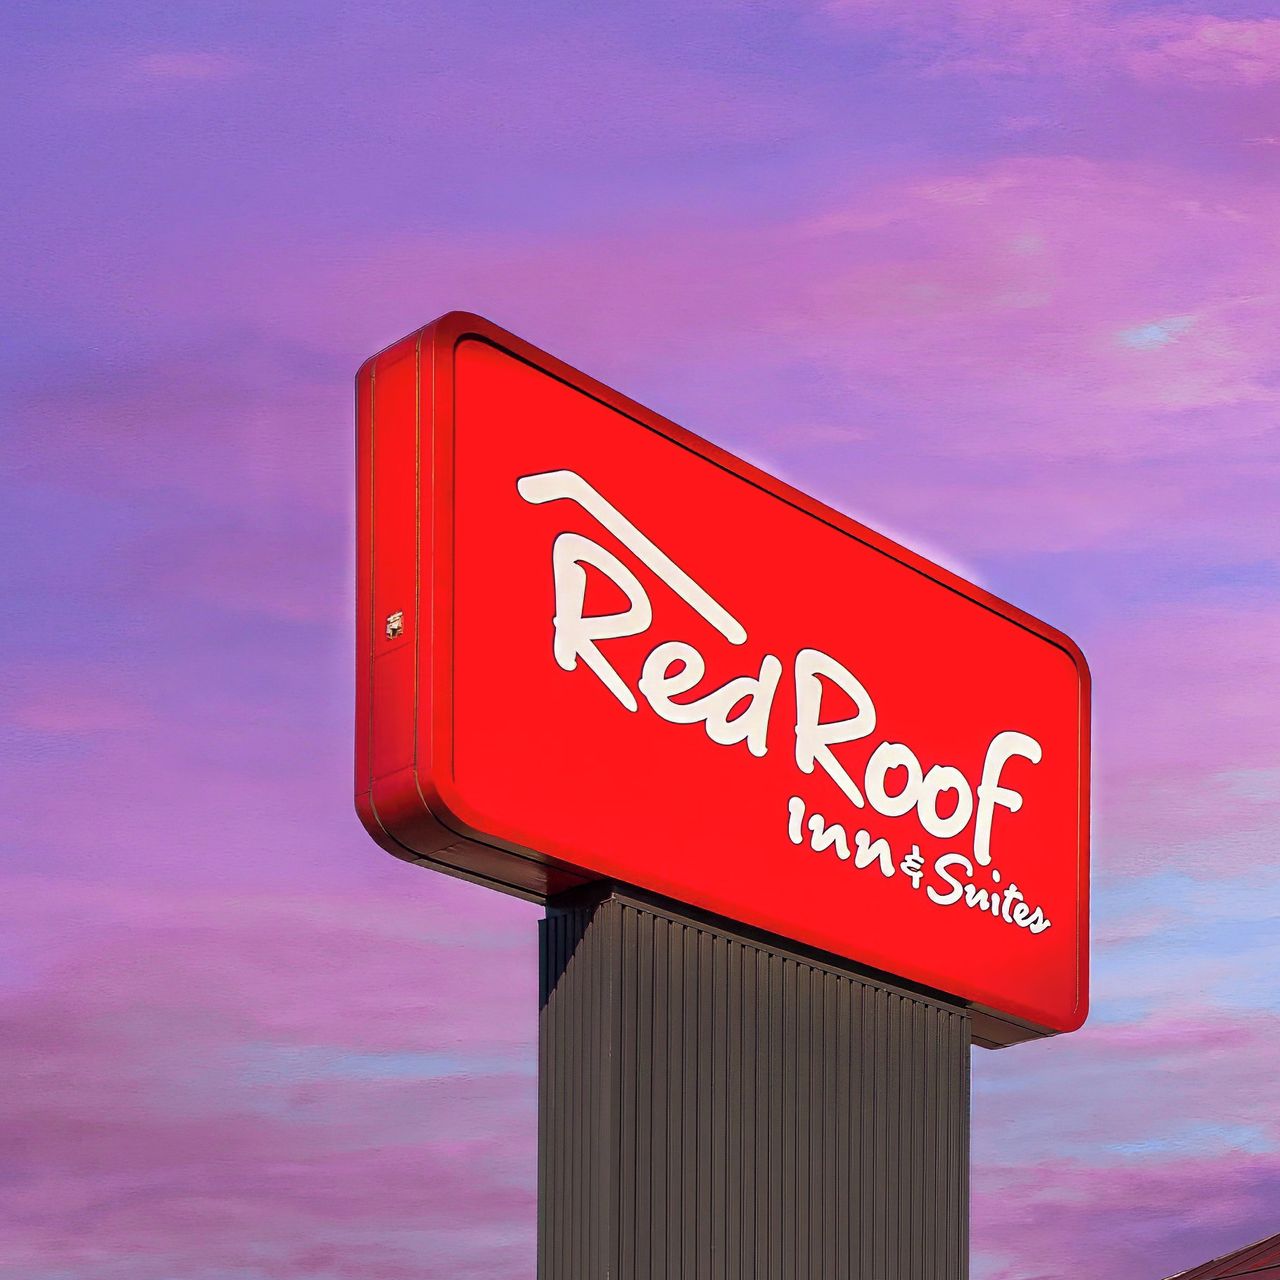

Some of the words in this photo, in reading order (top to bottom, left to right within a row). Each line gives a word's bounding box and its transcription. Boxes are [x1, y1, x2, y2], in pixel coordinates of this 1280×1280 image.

[787, 796, 896, 878] Inn
[900, 844, 925, 889] &
[926, 853, 1052, 934] Suites
